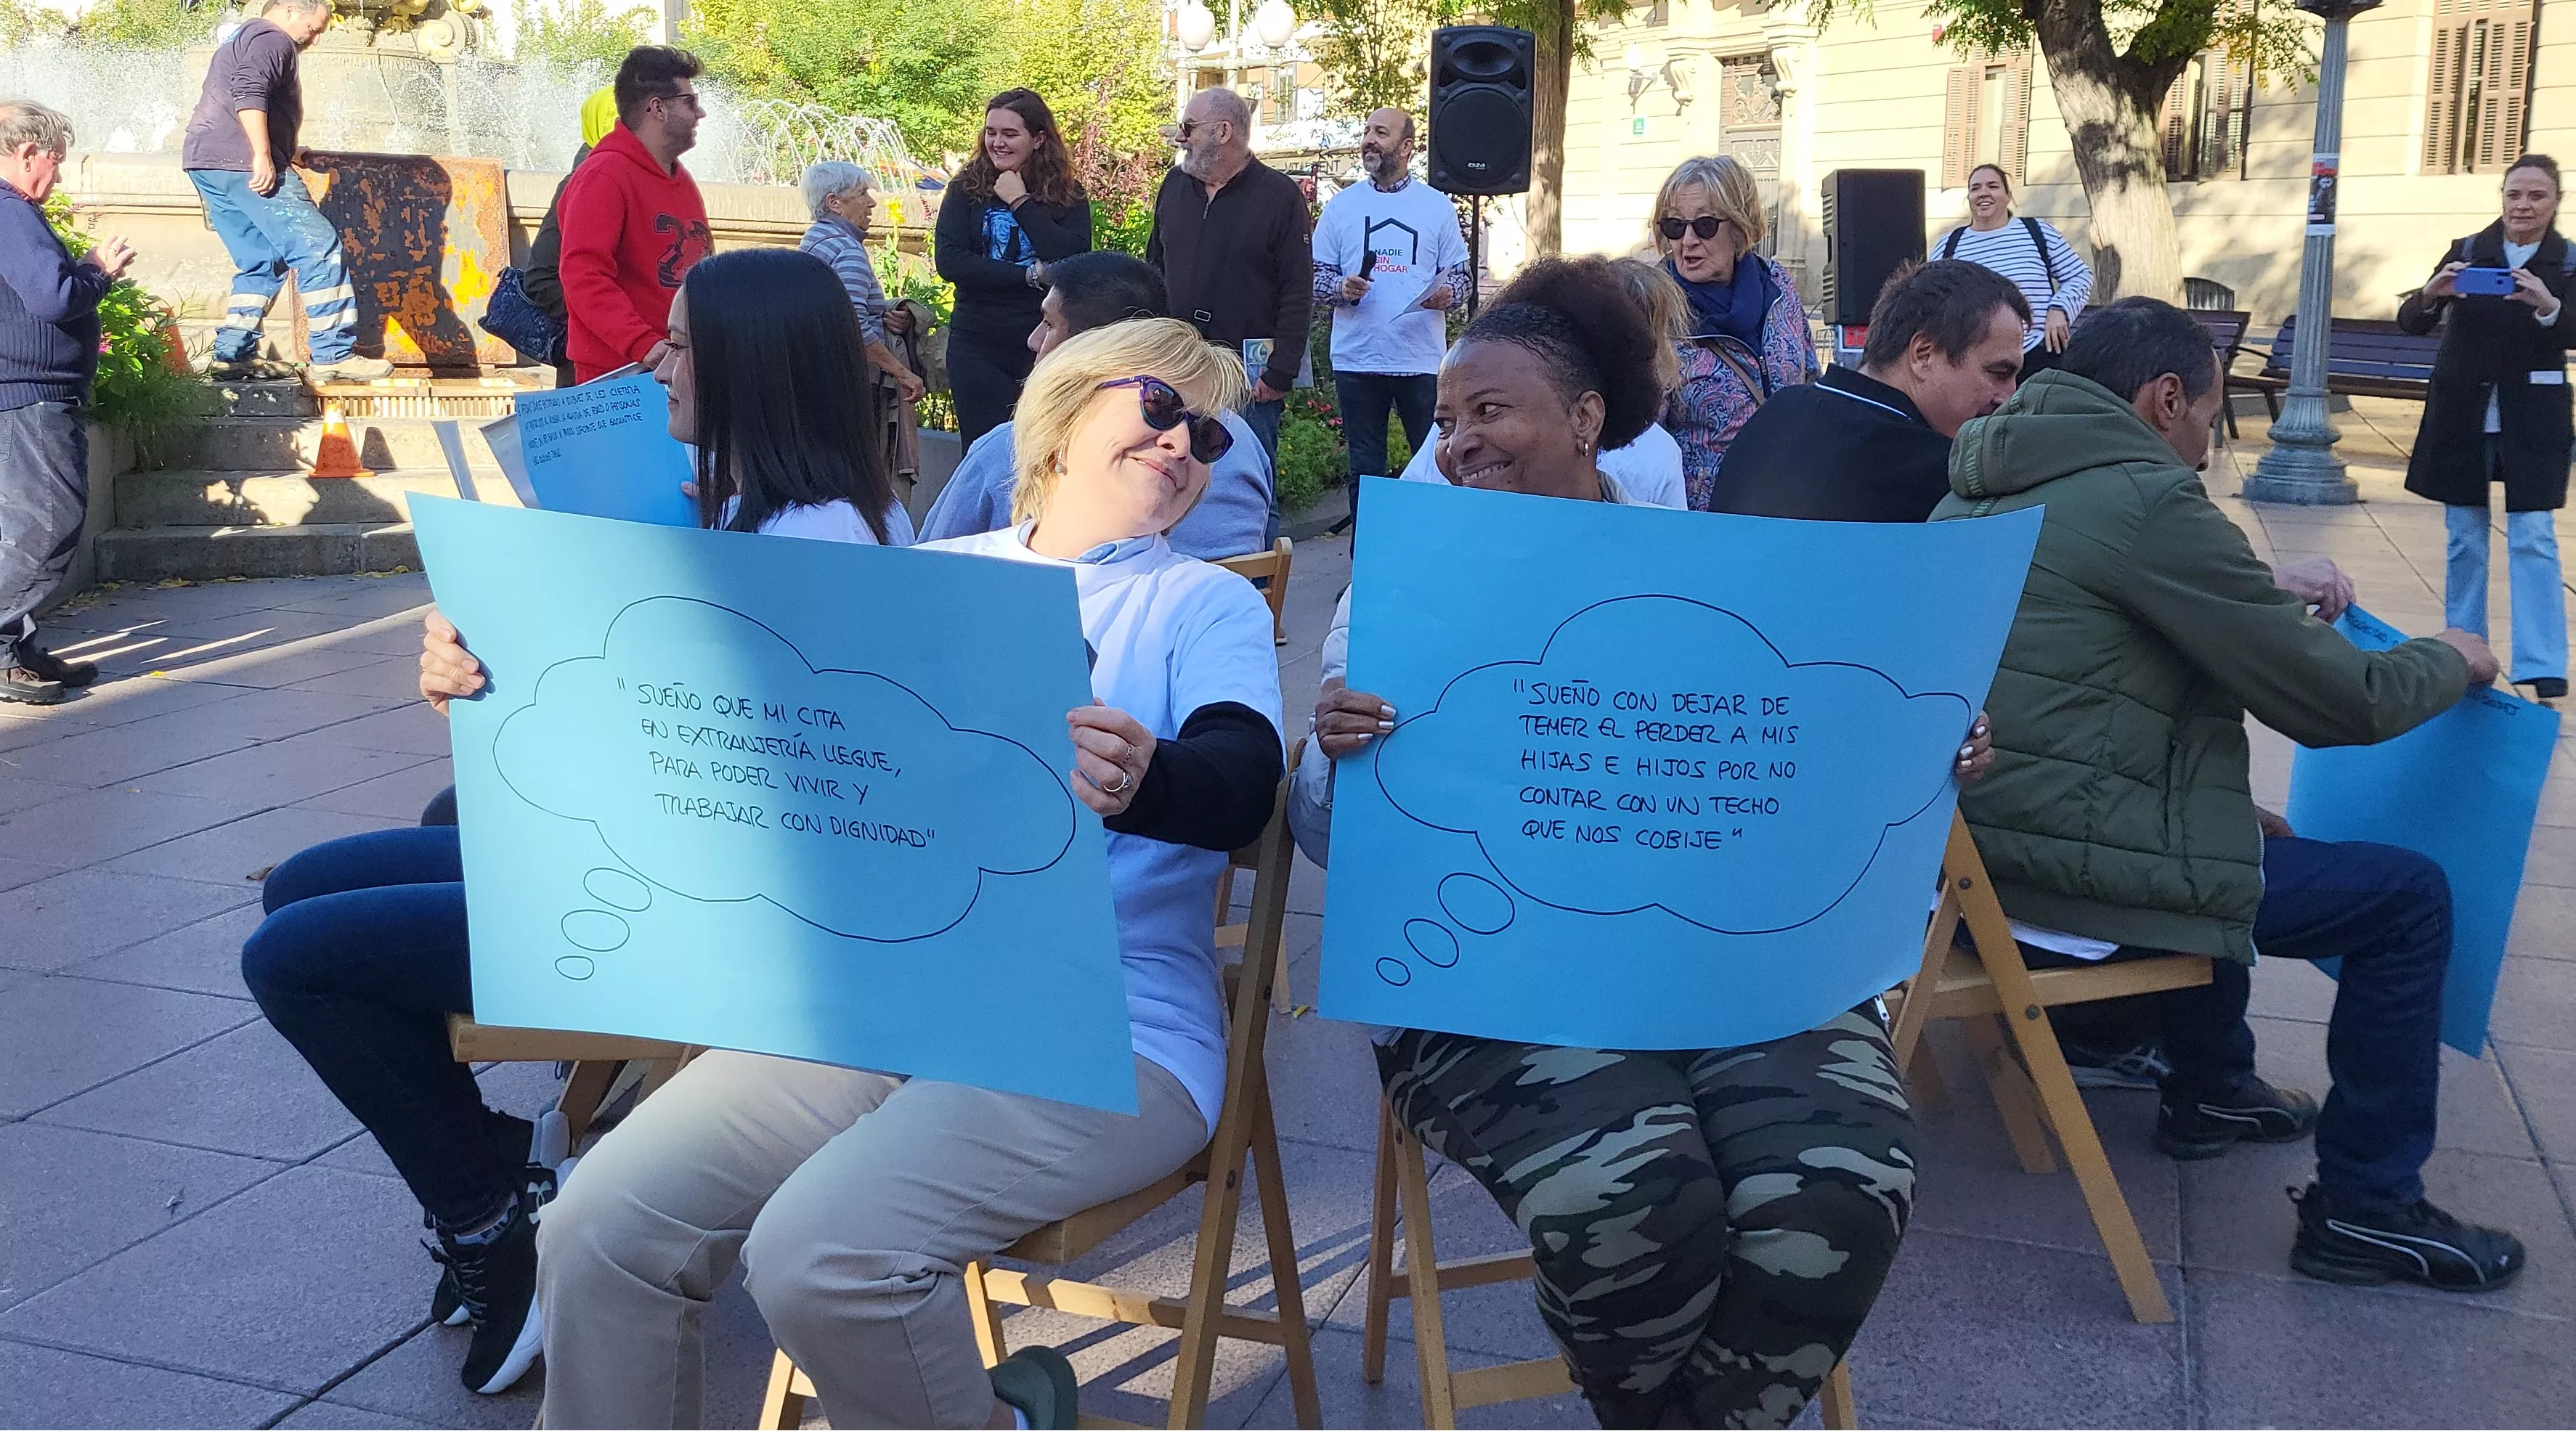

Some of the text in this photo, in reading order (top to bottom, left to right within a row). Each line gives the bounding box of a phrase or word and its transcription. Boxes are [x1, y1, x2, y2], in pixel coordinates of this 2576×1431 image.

[1373, 264, 1407, 274] HOGAR
[713, 695, 753, 719] QUE
[764, 703, 788, 724] MI
[797, 707, 846, 731] CITA
[1613, 691, 1657, 712] CON
[1672, 693, 1747, 716] DEJAR
[1761, 697, 1789, 715] DE
[1519, 715, 1799, 745] TEMER EL PERDER A MIS
[641, 719, 901, 778] EN EXTRANJERÍA LLEGUE,
[649, 751, 868, 805] PARA PODER VIVIR Y
[1521, 749, 1795, 780] HIJAS E HIJOS POR NO
[1520, 787, 1779, 815] CONTAR CON UN TECHO
[654, 794, 934, 847] TRABAJAR CON DIGNIDAD"
[1522, 819, 1566, 840] QUE
[1576, 825, 1621, 843] NOS
